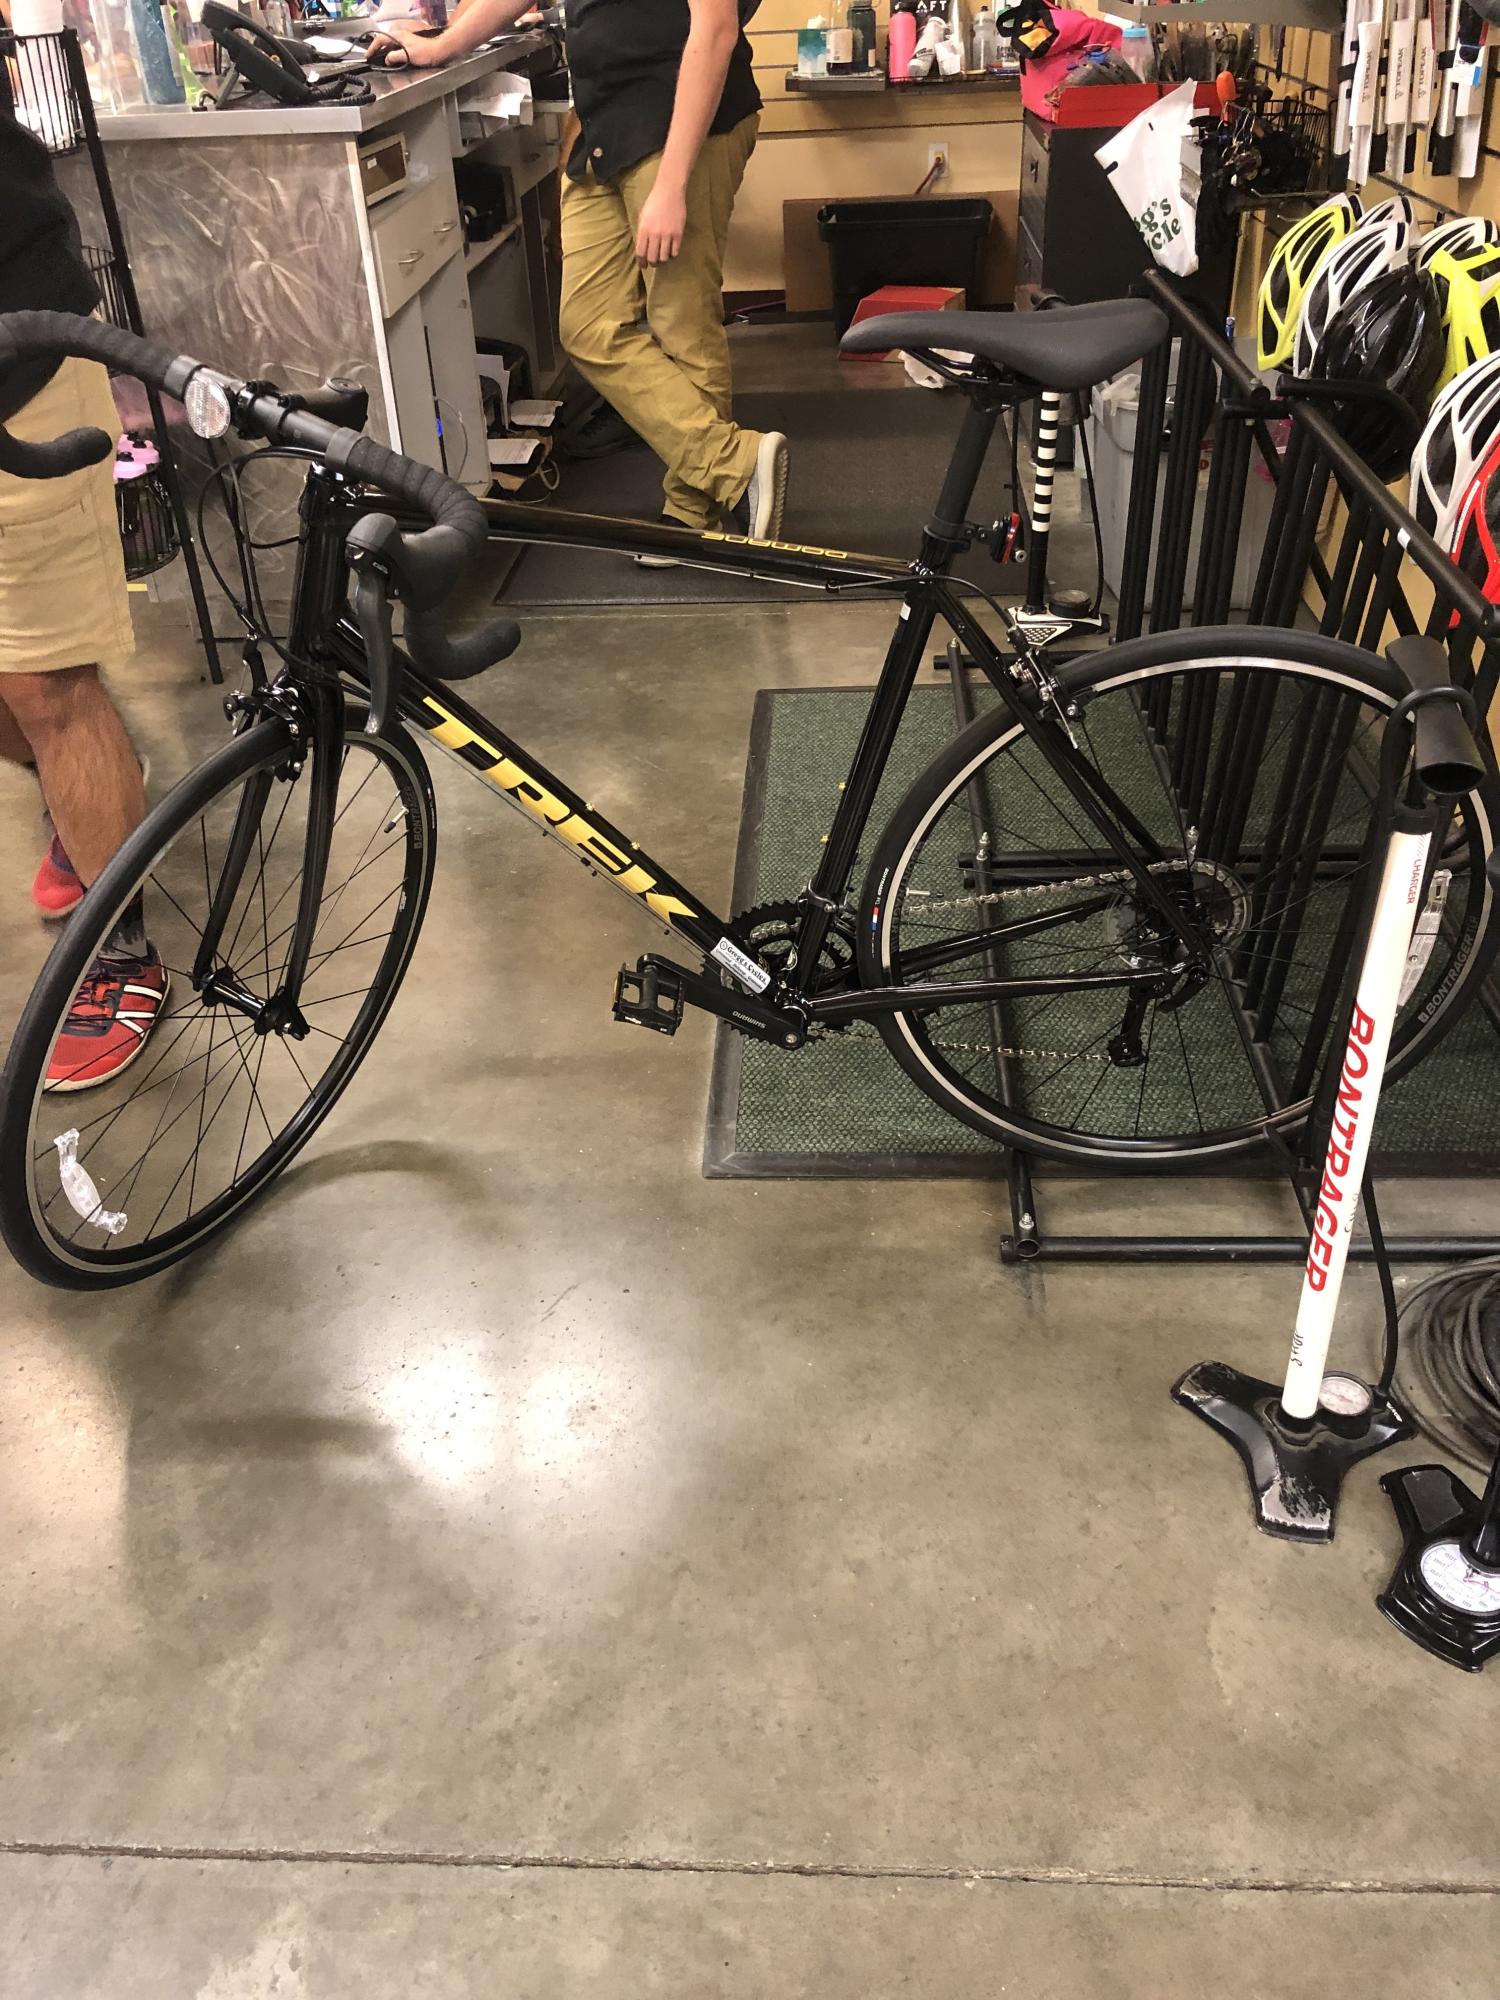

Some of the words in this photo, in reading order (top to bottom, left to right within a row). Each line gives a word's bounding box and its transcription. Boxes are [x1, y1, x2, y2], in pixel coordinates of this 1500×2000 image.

[1364, 51, 1373, 90] TOPEAK
[1396, 47, 1405, 86] TOPEAK
[1418, 46, 1427, 85] TOPEAK
[701, 531, 848, 560] DOMANE
[422, 696, 699, 925] TREK
[877, 866, 890, 896] BONTRAGER
[1425, 932, 1478, 1017] BONTRAGER
[732, 1010, 767, 1029] SHIMANO
[1305, 1002, 1375, 1292] BONTRAGER
